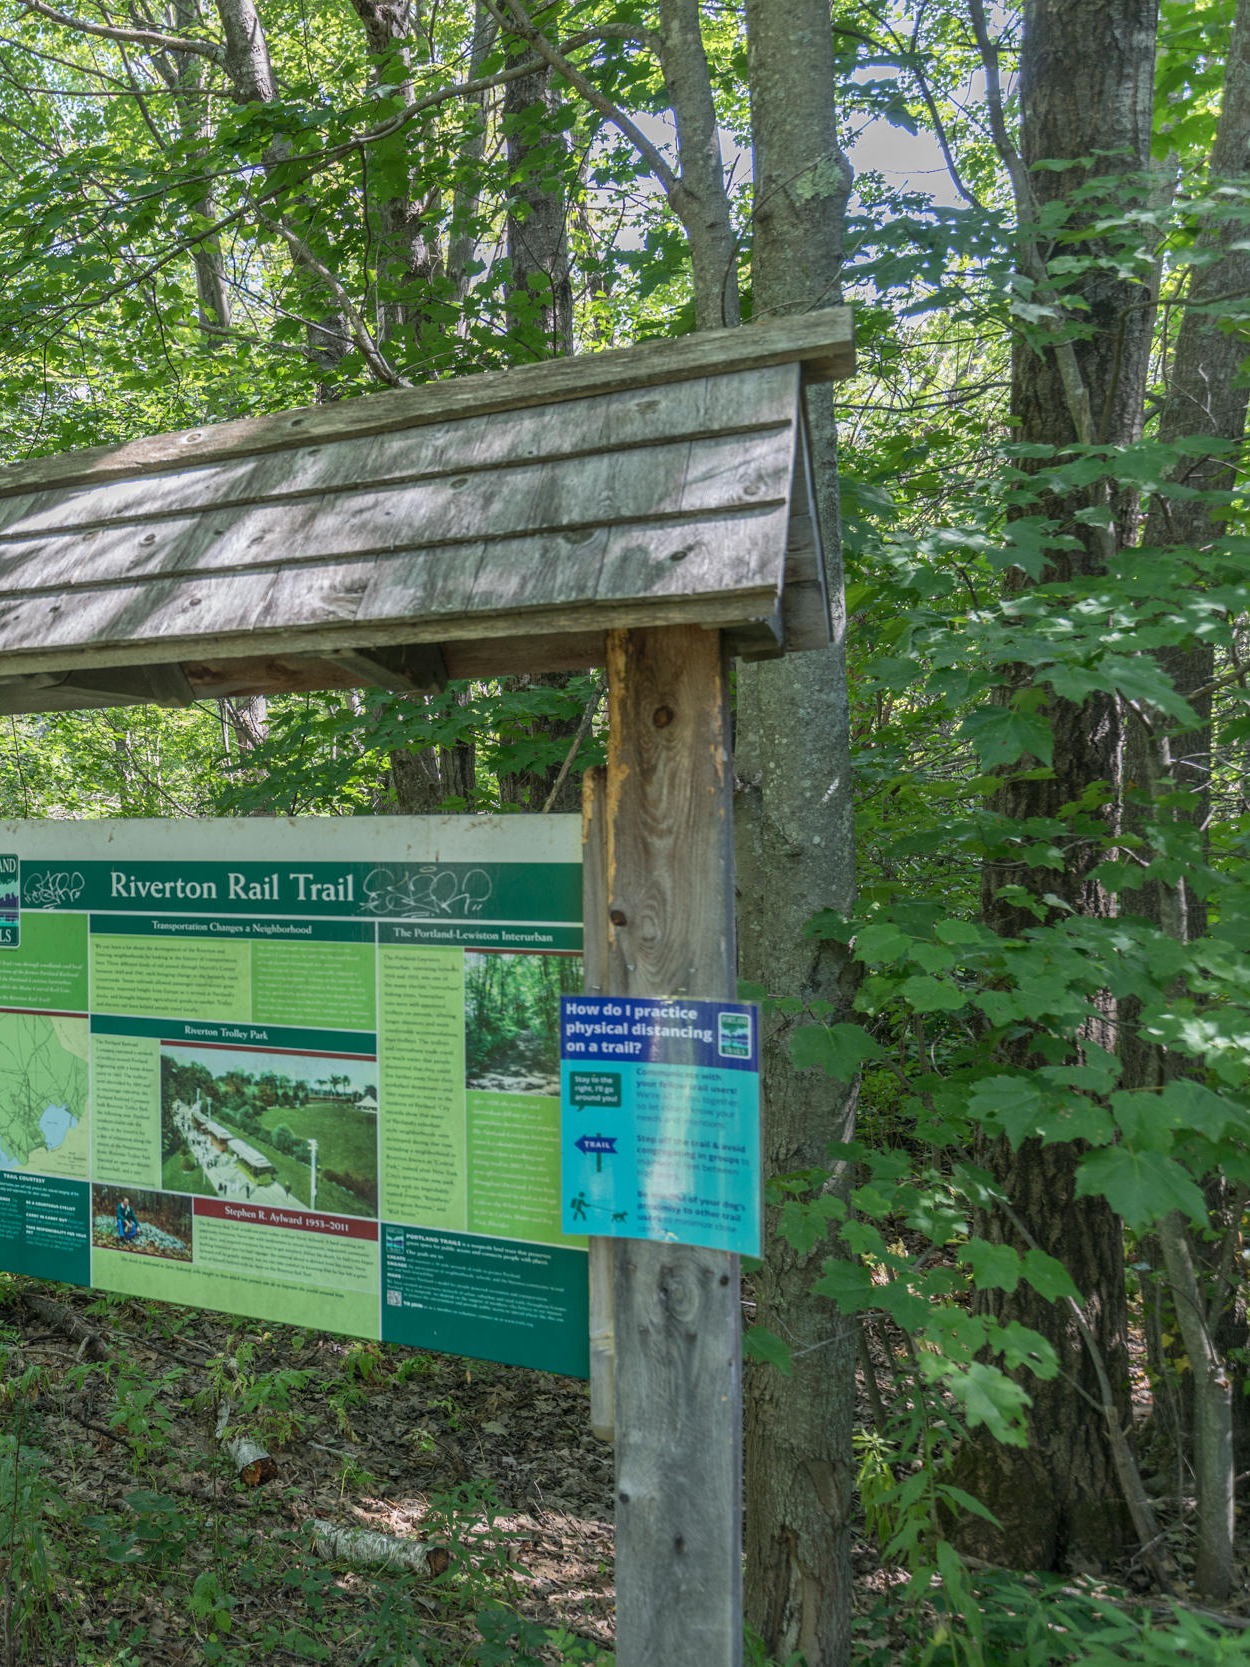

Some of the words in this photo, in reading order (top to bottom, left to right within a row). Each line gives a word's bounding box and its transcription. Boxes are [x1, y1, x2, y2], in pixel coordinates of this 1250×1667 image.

[110, 871, 216, 899] Riverton
[228, 872, 279, 900] Rail
[290, 874, 354, 901] Trail
[152, 920, 208, 932] Transportation
[210, 922, 244, 934] Changes
[252, 924, 312, 934] Neighborhood
[393, 927, 412, 938] The
[414, 928, 498, 940] Portland-Lewiston
[502, 930, 553, 942] Interurban
[566, 1003, 599, 1016] How
[603, 1004, 622, 1016] do
[626, 1005, 630, 1016] I
[634, 1006, 698, 1020] practice
[184, 1025, 218, 1036] Riverton
[220, 1028, 248, 1040] Trolley
[250, 1030, 268, 1040] Park
[566, 1021, 628, 1037] physical
[632, 1023, 713, 1043] distancing
[566, 1042, 584, 1052] on
[588, 1042, 598, 1052] a
[602, 1041, 642, 1054] trail?
[574, 1076, 590, 1084] Stay
[3, 1173, 18, 1181] TRAIL
[19, 1175, 45, 1184] COURTESY
[224, 1206, 256, 1220] Stephen
[258, 1211, 267, 1220] R.
[270, 1212, 302, 1226] Aylward
[406, 1233, 438, 1242] PORTLAND
[439, 1238, 461, 1246] TRAILS
